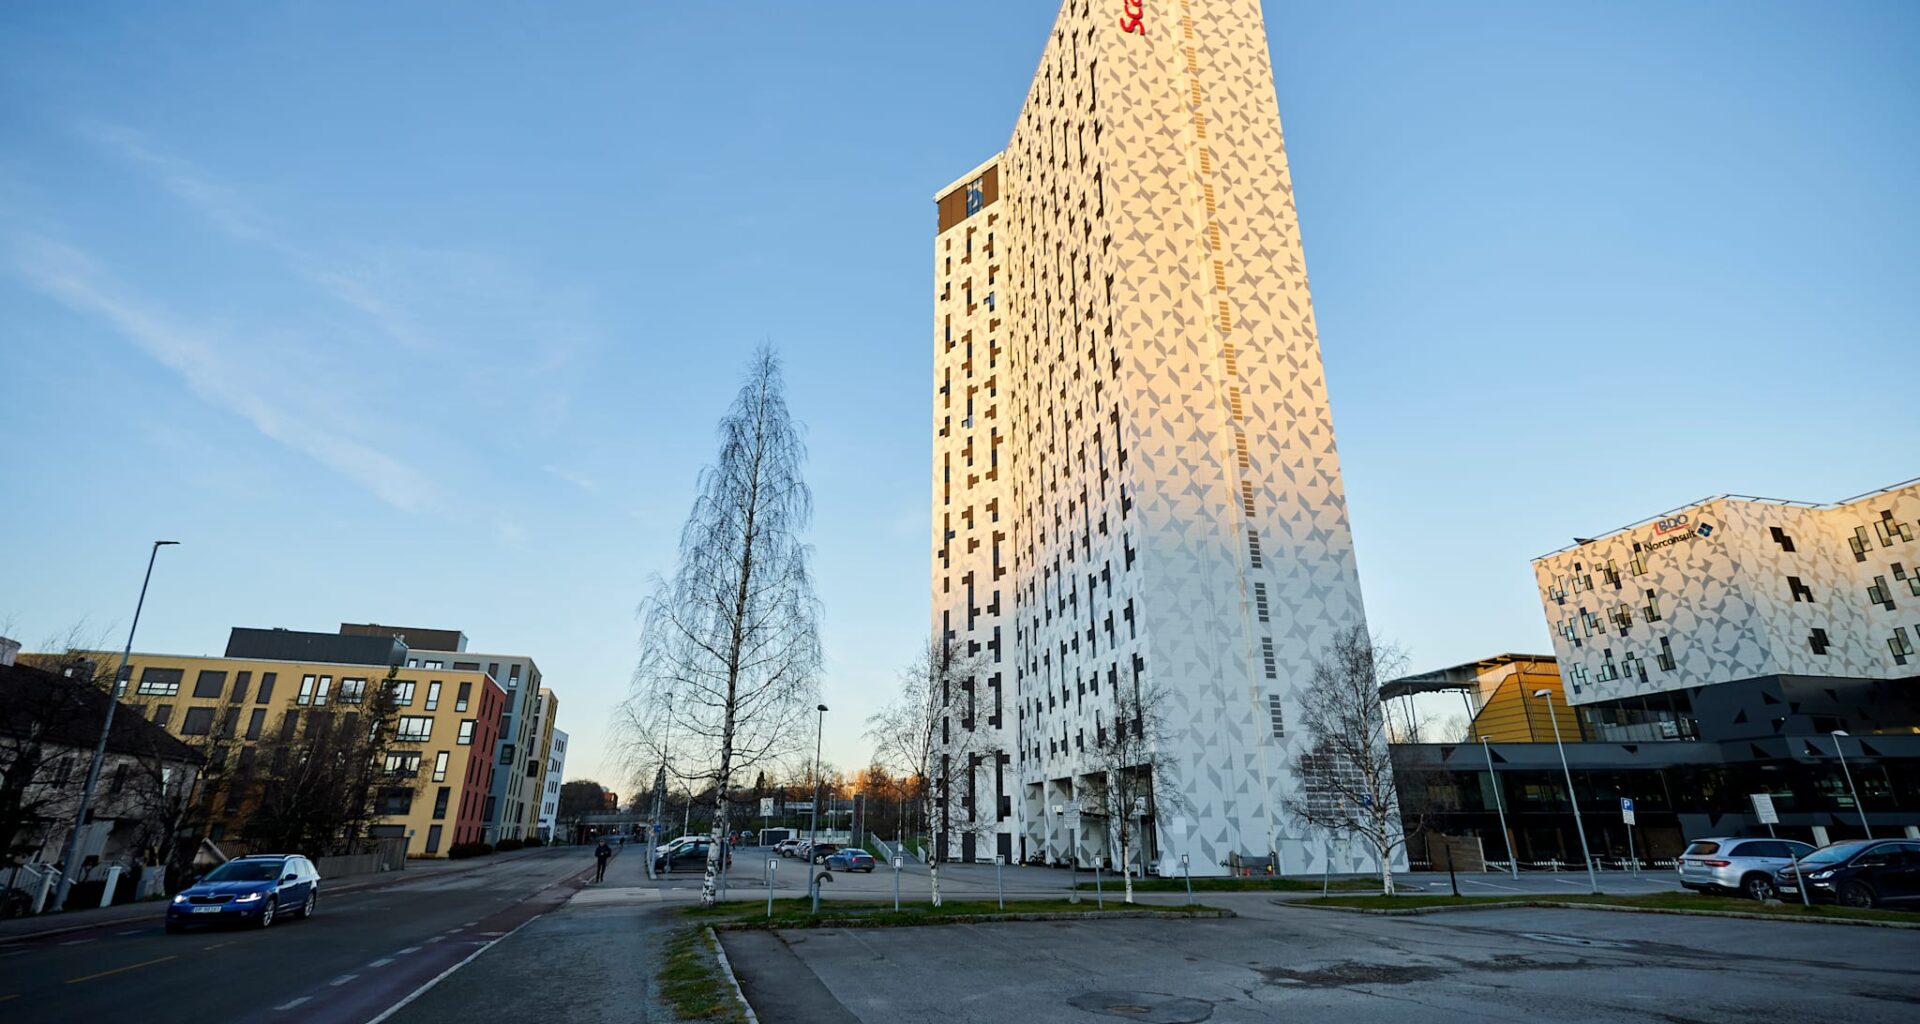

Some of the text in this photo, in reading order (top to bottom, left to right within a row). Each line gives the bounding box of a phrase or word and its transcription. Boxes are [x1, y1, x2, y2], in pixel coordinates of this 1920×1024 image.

[1658, 514, 1689, 532] BDO
[1644, 529, 1698, 552] Norconsult
[1623, 799, 1631, 809] P
